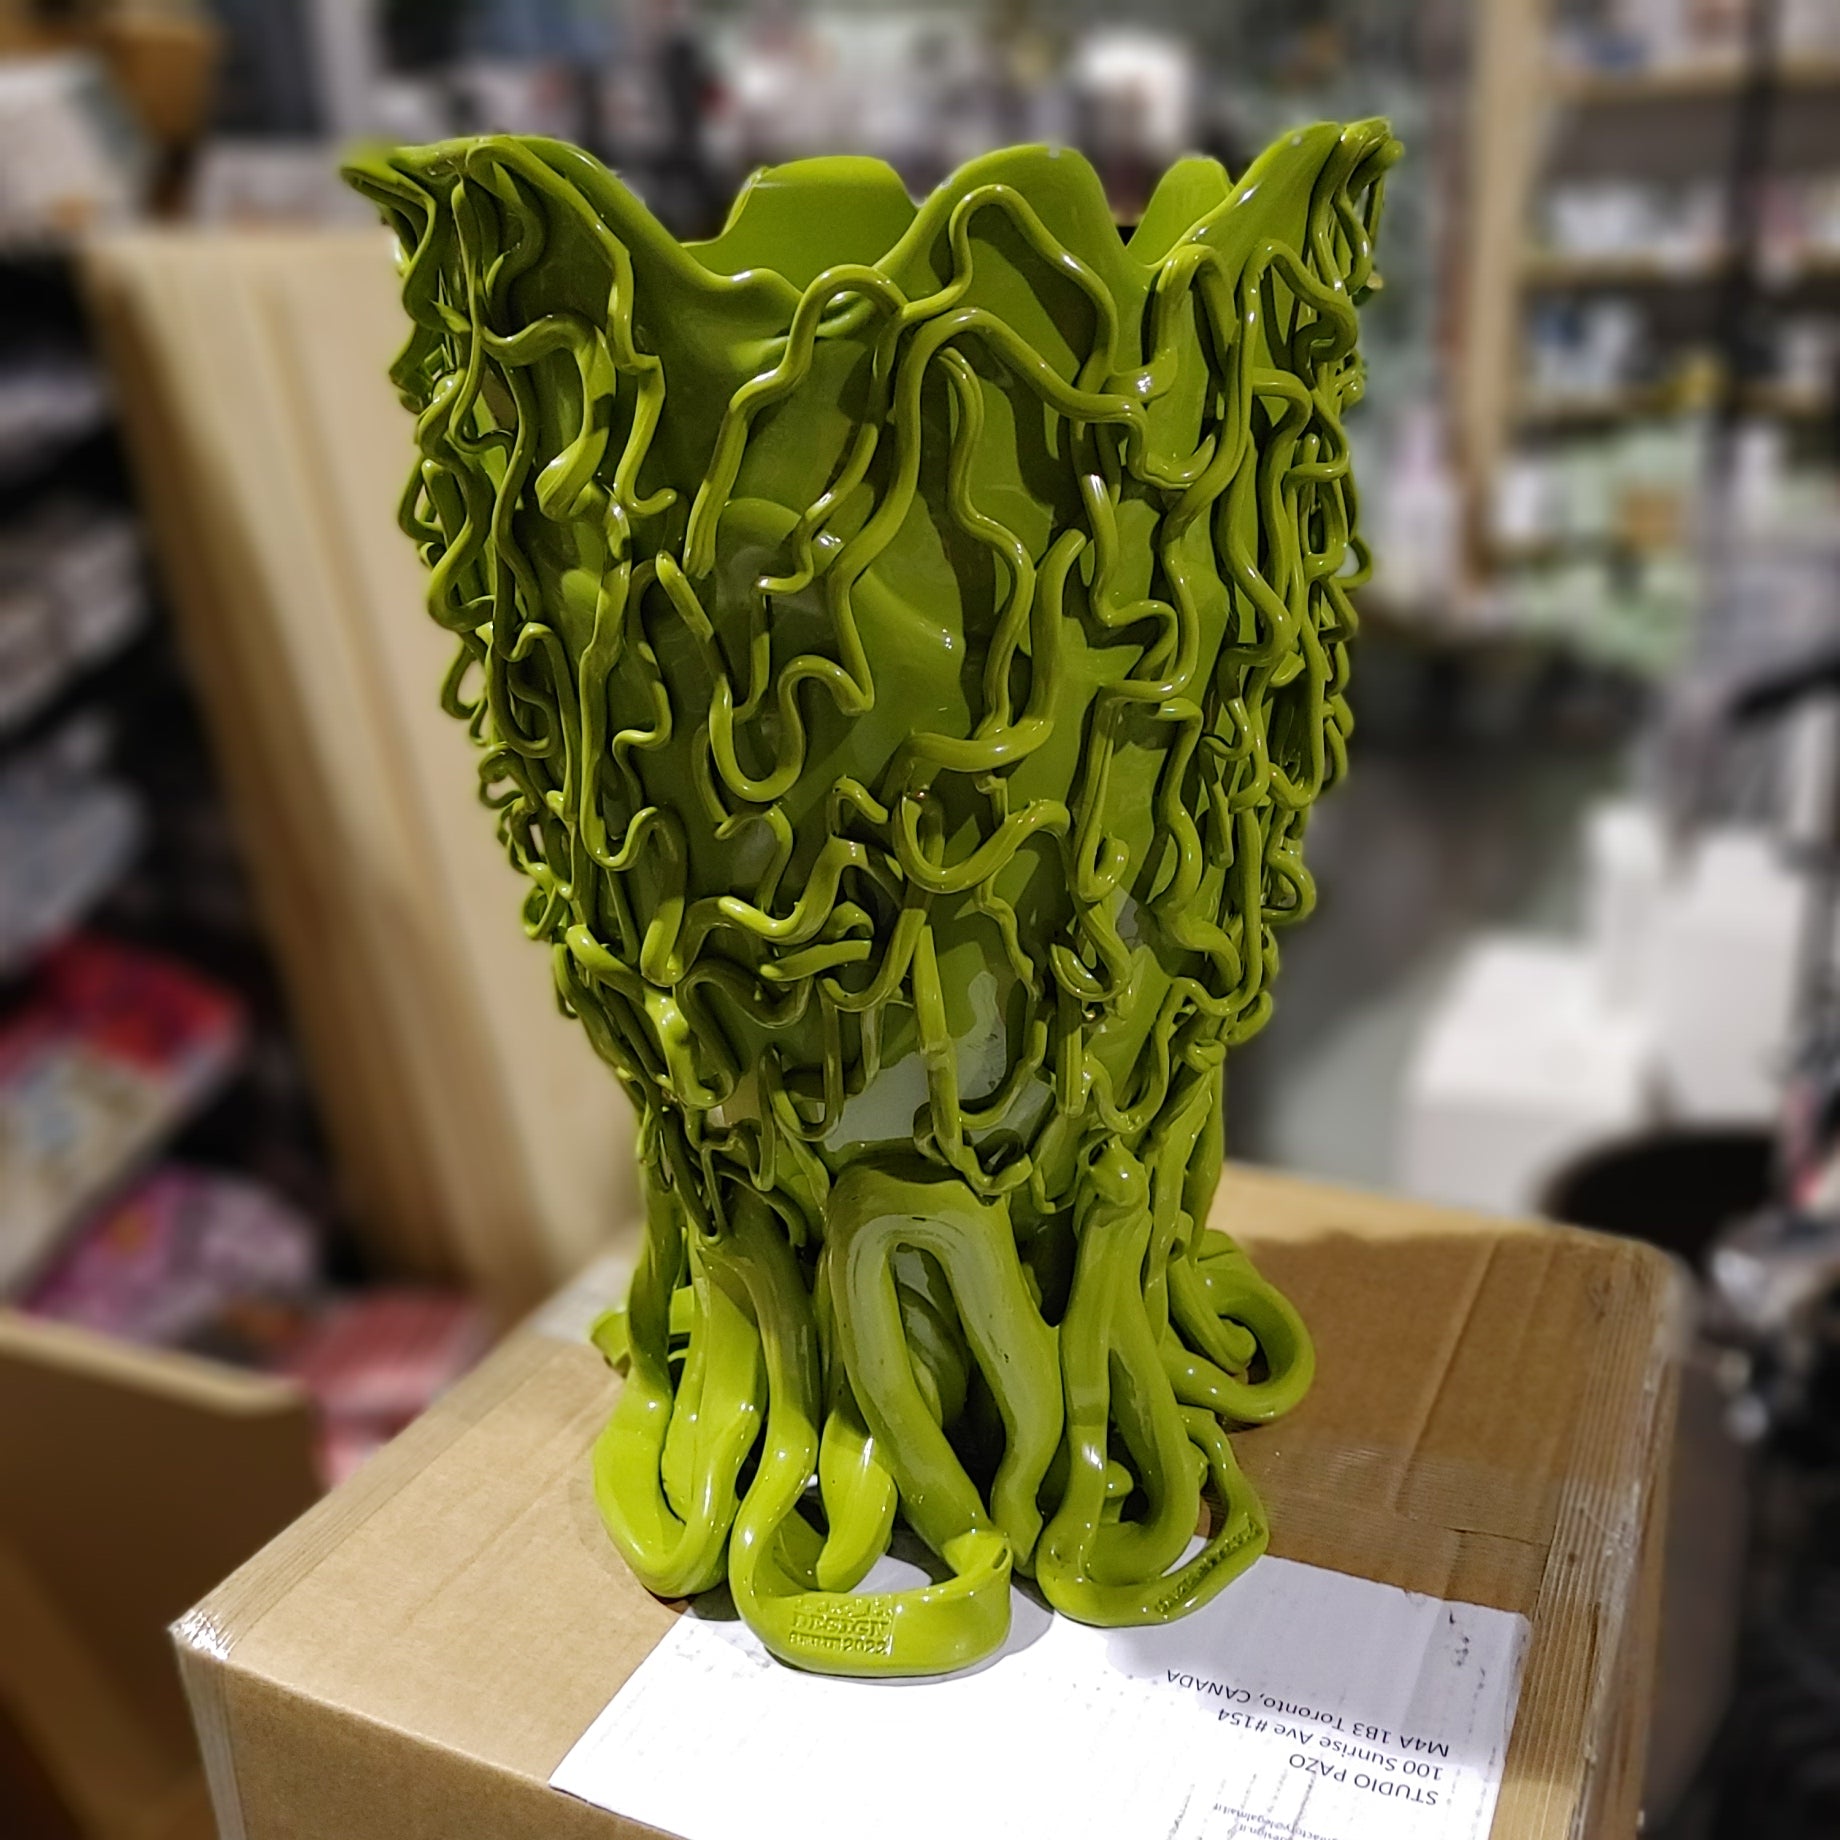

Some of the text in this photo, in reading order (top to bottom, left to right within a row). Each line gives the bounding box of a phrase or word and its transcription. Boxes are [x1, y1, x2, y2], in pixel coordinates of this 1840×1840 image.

[1167, 1669, 1449, 1758] M4A 1B3 Toronto, CANADA
[1218, 1708, 1444, 1781] 100 Sunrise Ave #154
[1289, 1753, 1440, 1806] STUDIO PAZO
